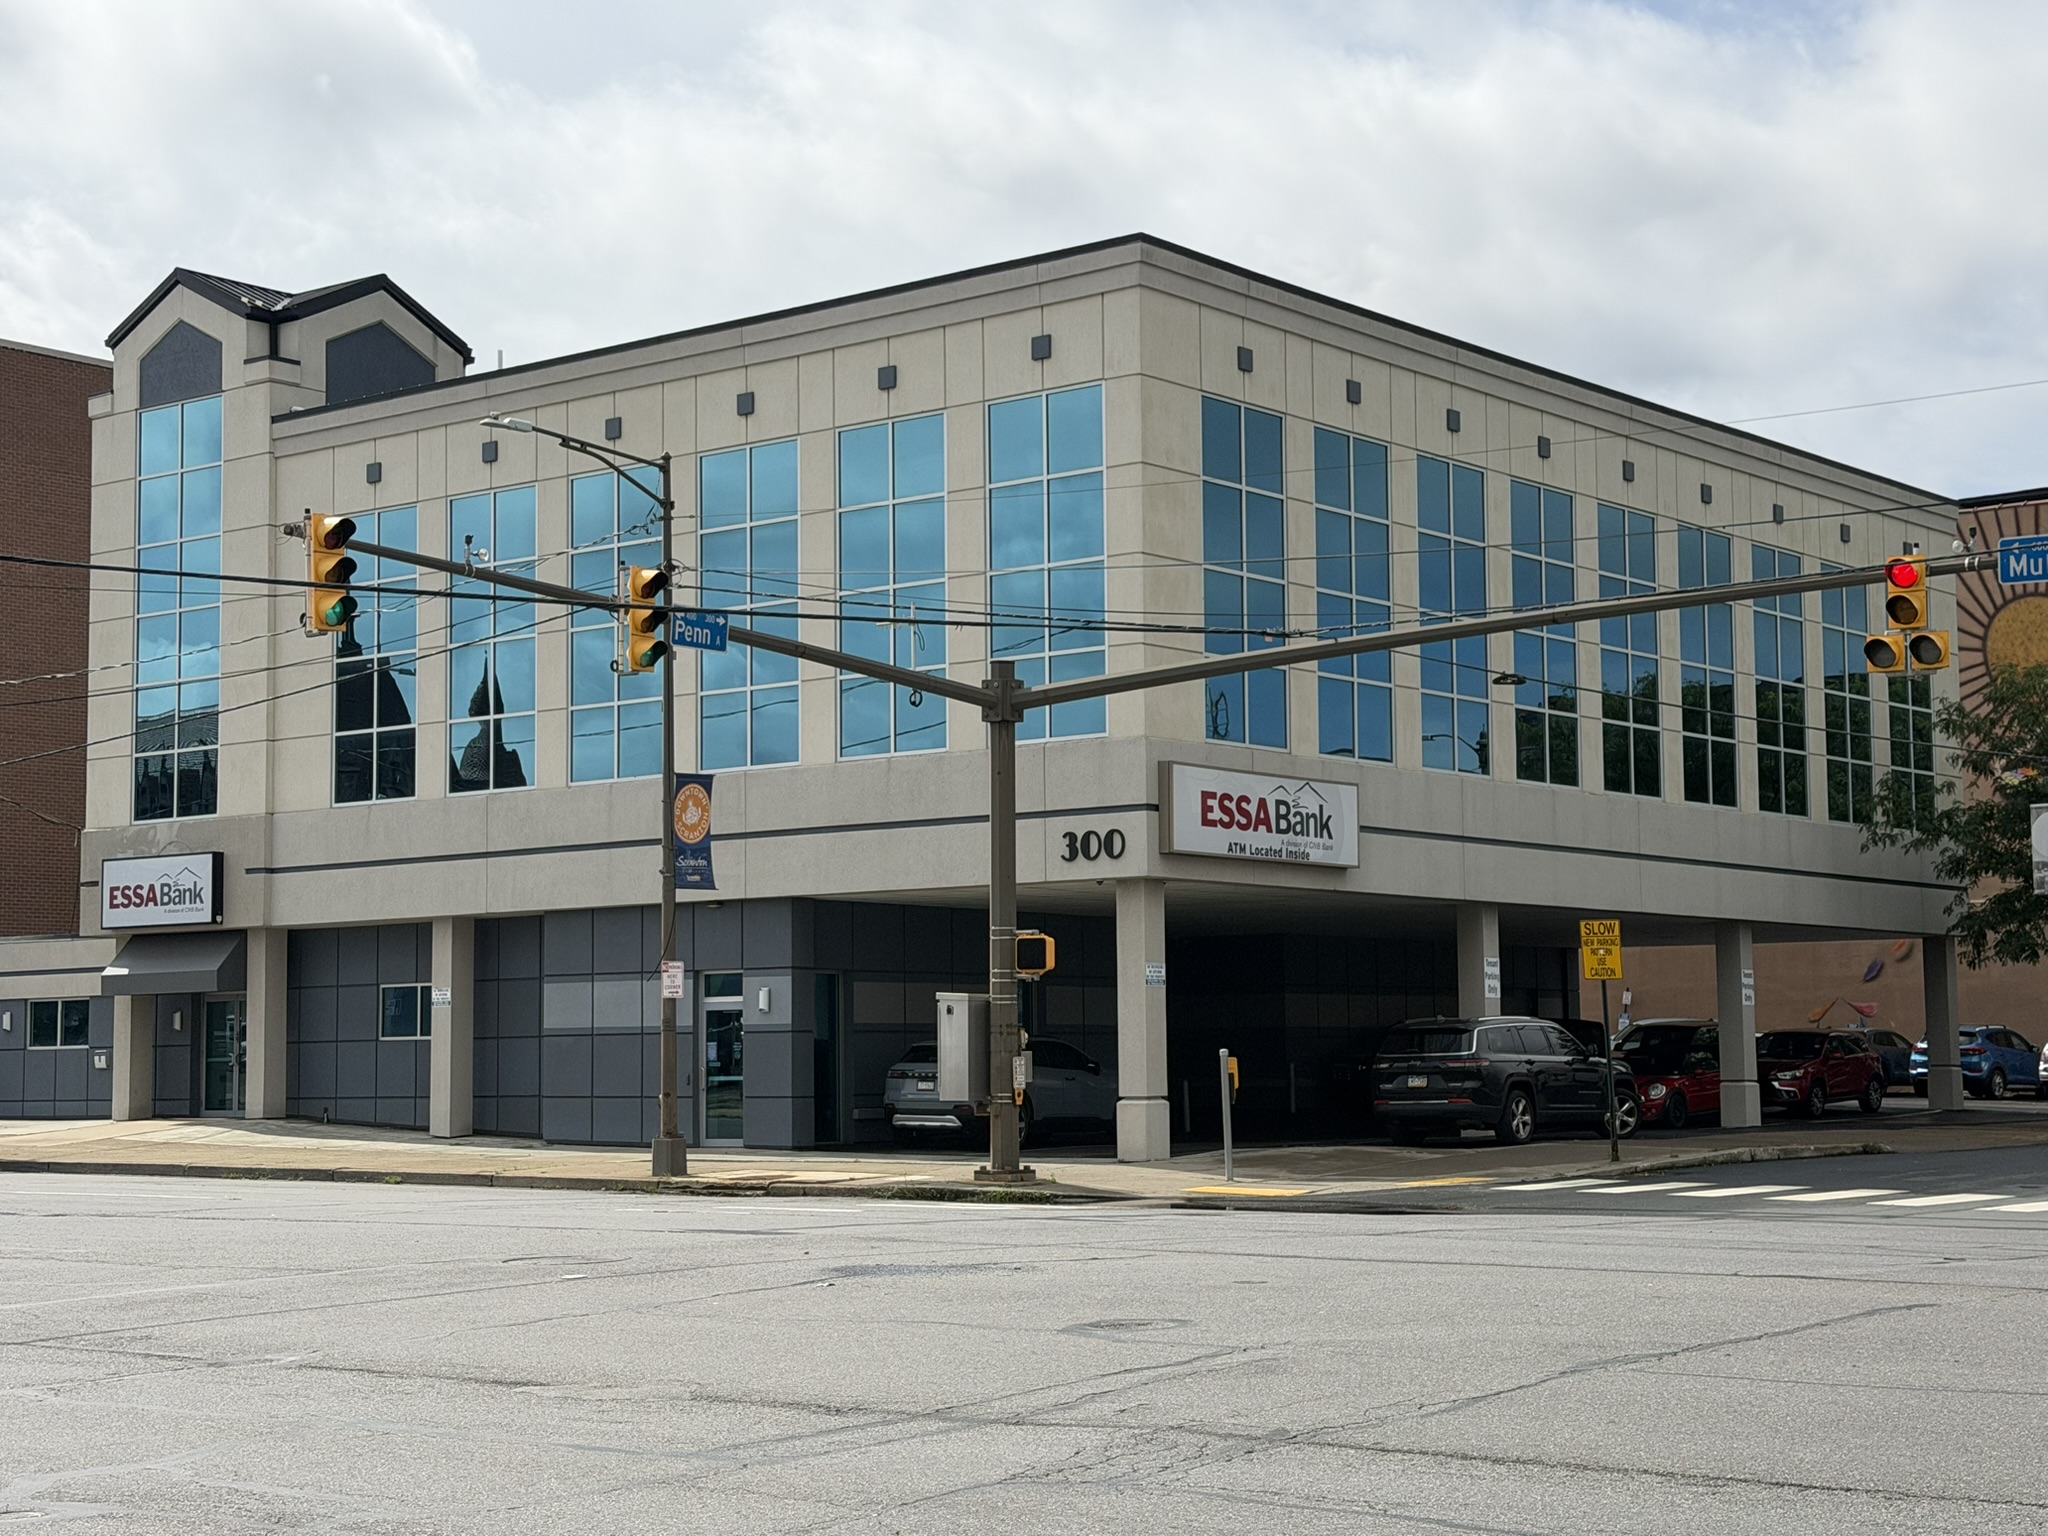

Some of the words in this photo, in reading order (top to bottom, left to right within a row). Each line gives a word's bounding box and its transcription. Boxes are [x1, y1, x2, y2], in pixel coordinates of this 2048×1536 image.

[675, 620, 711, 645] Penn
[676, 787, 709, 815] DOWNTOWN
[676, 812, 709, 840] SCRANTON
[1061, 828, 1126, 862] 300
[1227, 841, 1246, 855] ATM
[1250, 843, 1282, 859] Located
[1286, 847, 1310, 860] Inside
[1322, 842, 1333, 851] Bank
[1584, 922, 1616, 935] SLOW
[1596, 937, 1619, 947] PARKING
[1597, 957, 1607, 966] USE
[1590, 967, 1616, 977] CAUTION
